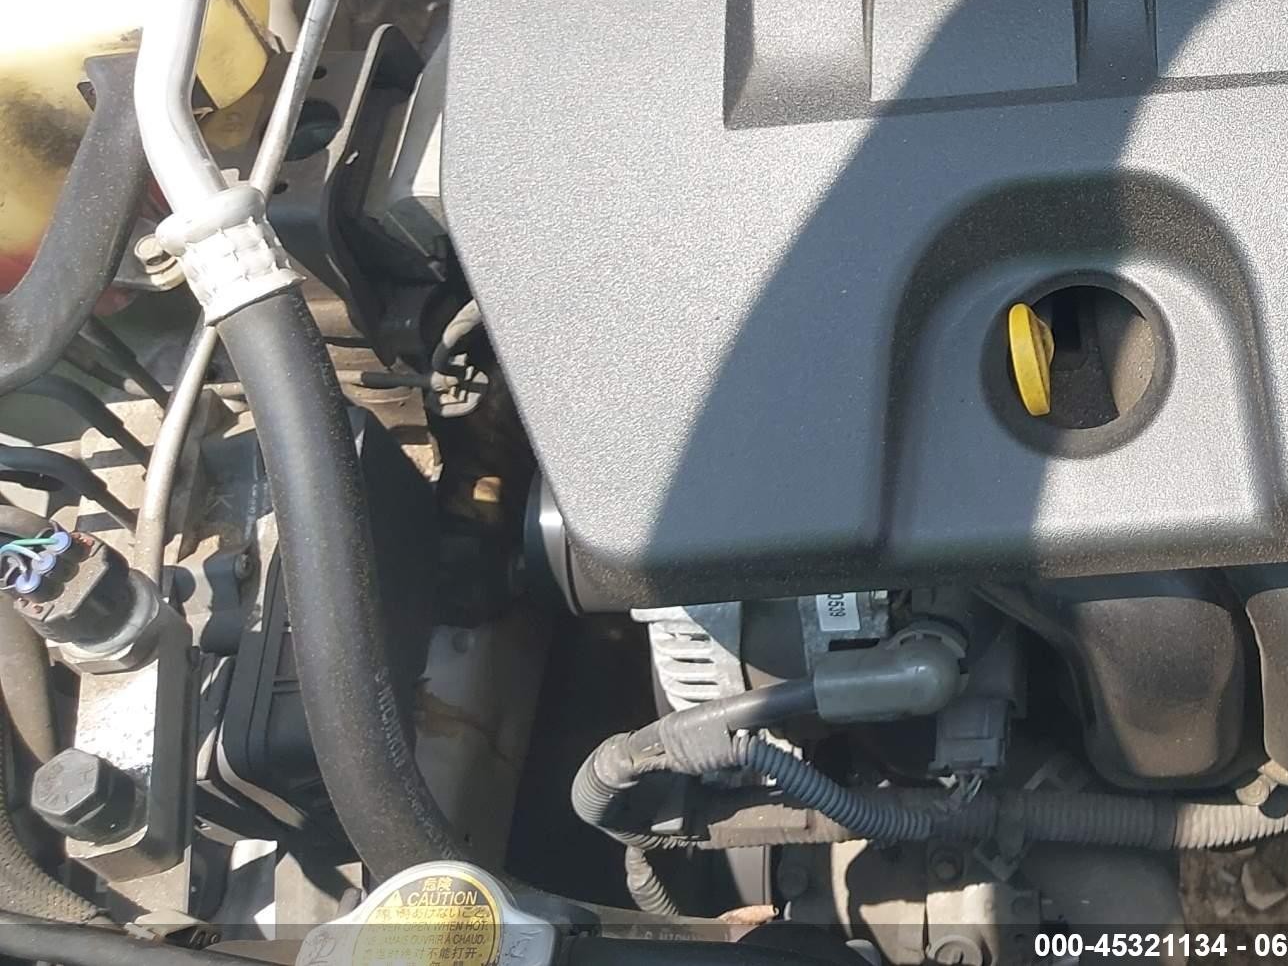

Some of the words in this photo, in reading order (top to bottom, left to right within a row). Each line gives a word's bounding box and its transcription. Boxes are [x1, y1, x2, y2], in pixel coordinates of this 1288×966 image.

[406, 890, 478, 906] CAUTION
[403, 921, 431, 931] OPEN
[433, 921, 464, 931] WHEN
